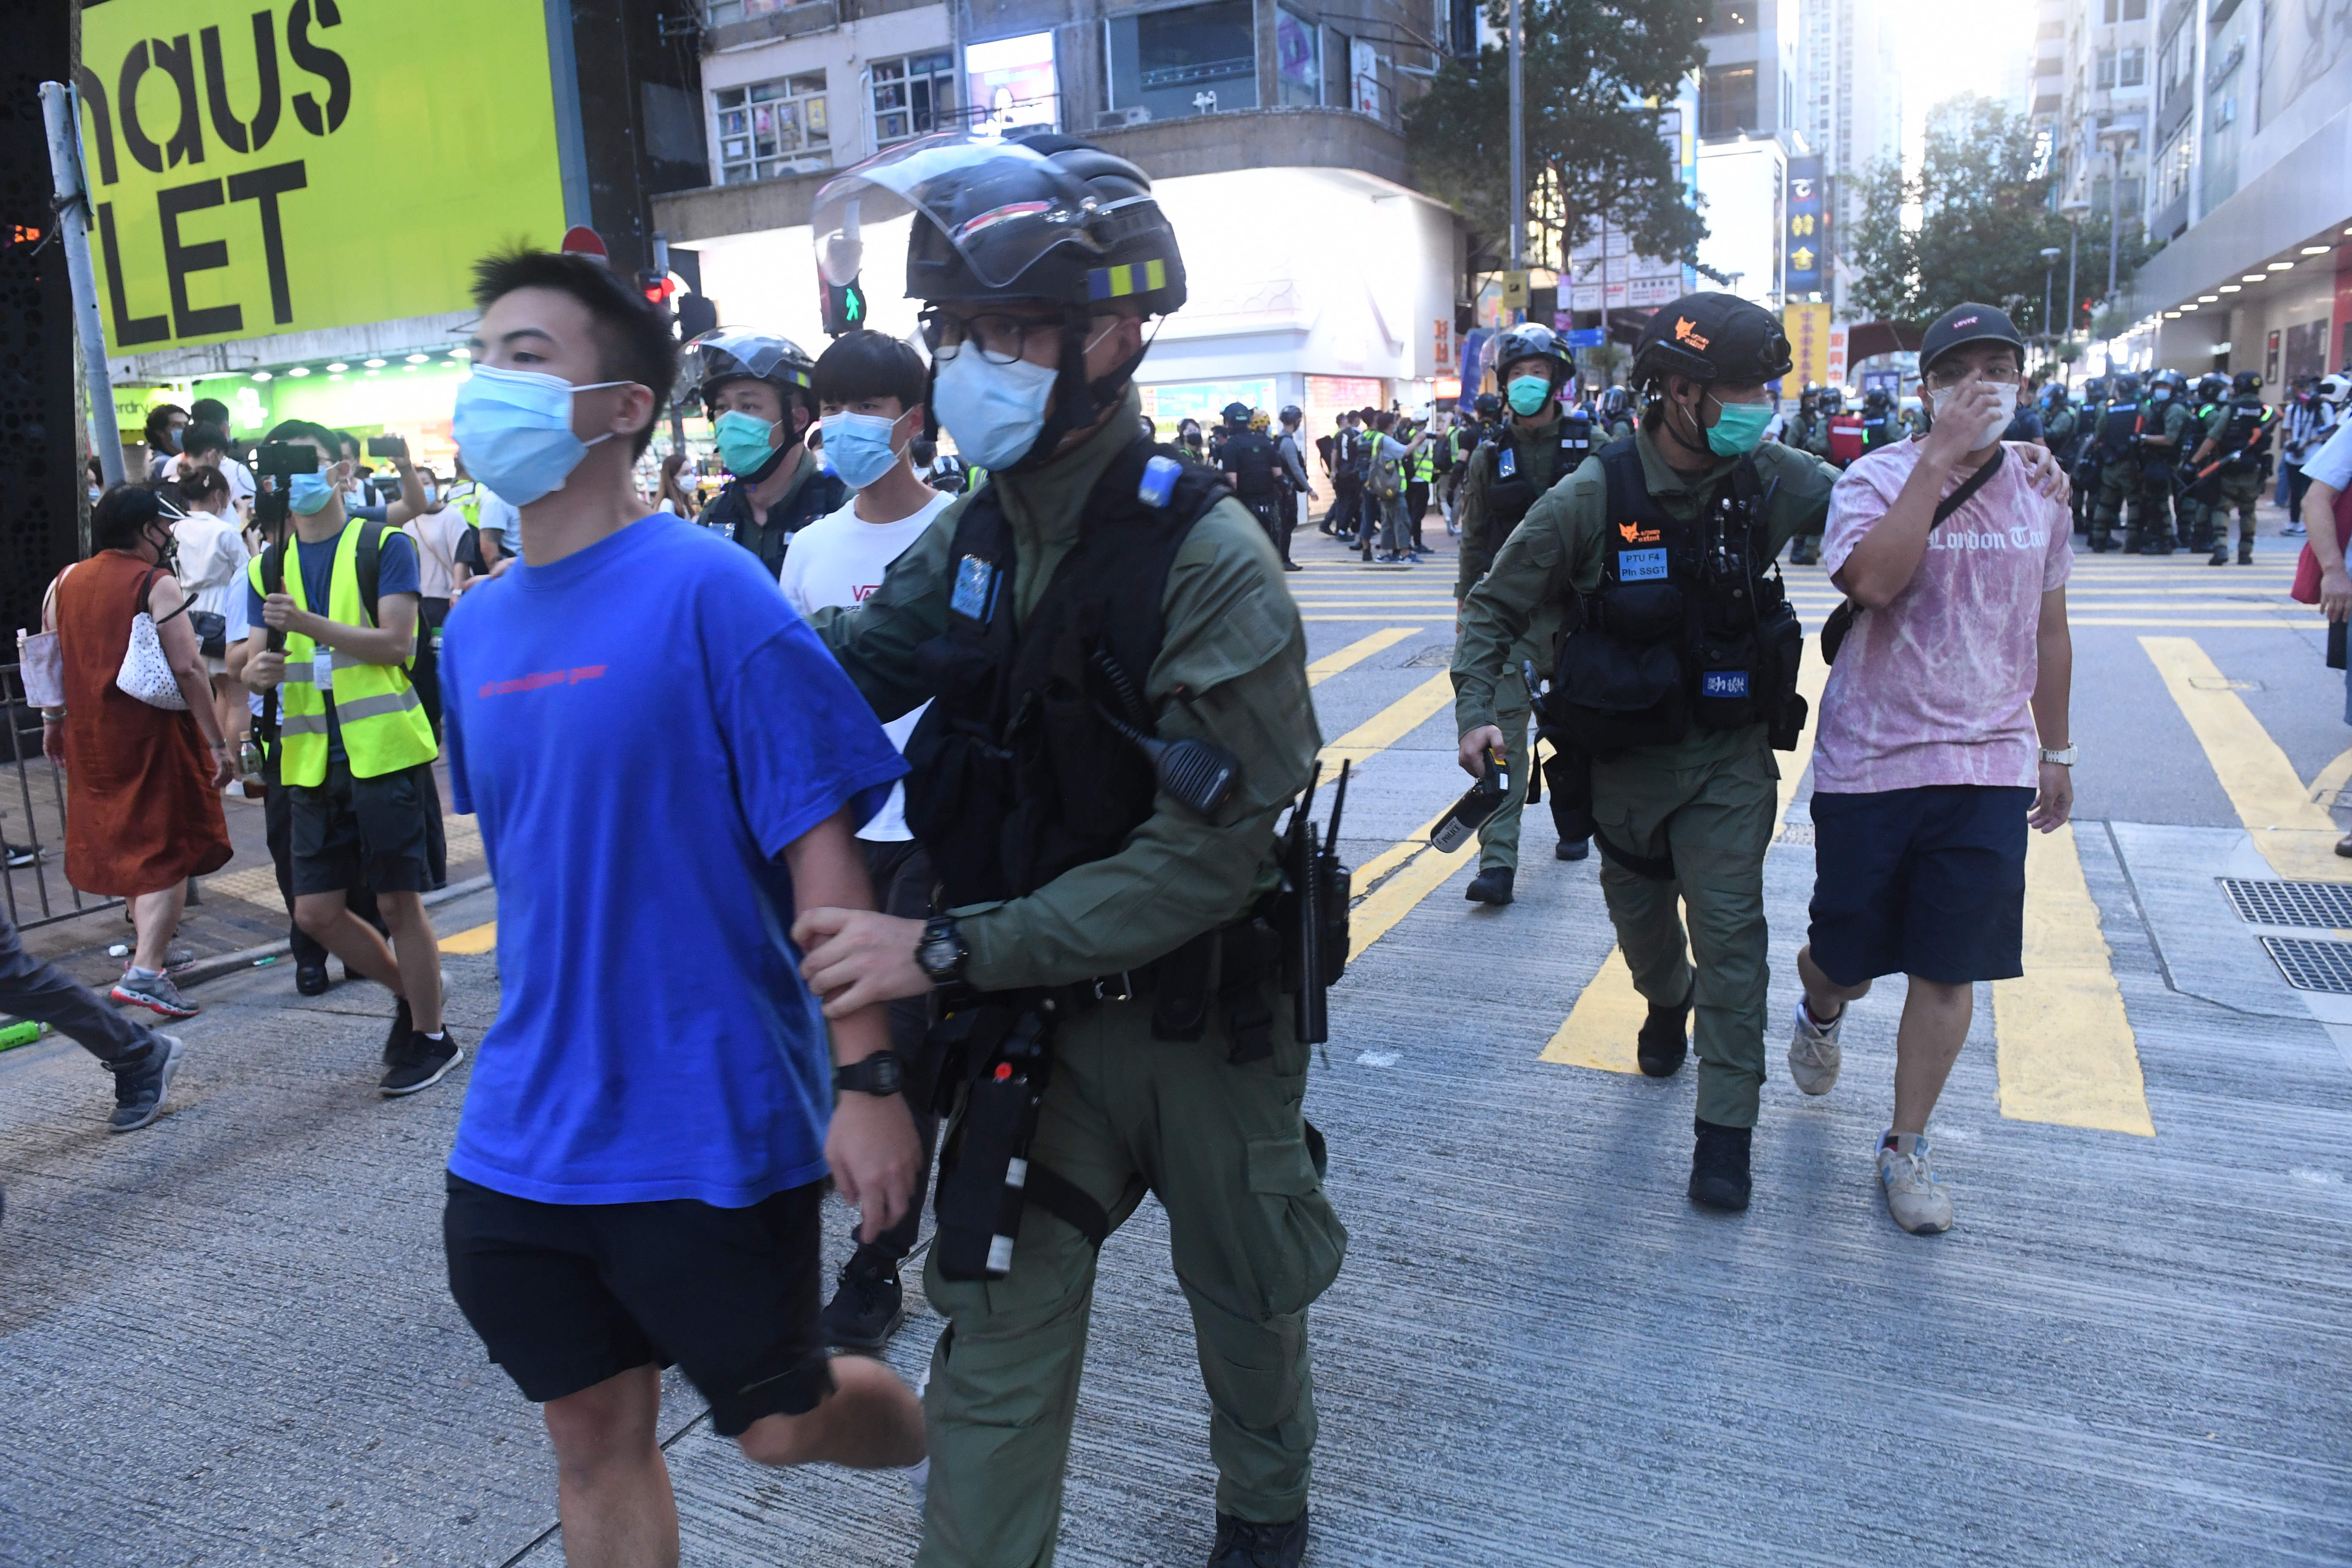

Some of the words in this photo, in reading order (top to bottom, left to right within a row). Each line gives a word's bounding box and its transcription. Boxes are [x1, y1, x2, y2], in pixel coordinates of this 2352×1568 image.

[86, 160, 307, 347] LET
[1927, 527, 2006, 550] London
[1626, 554, 1645, 563] PTU
[1640, 566, 1666, 575] SSGT
